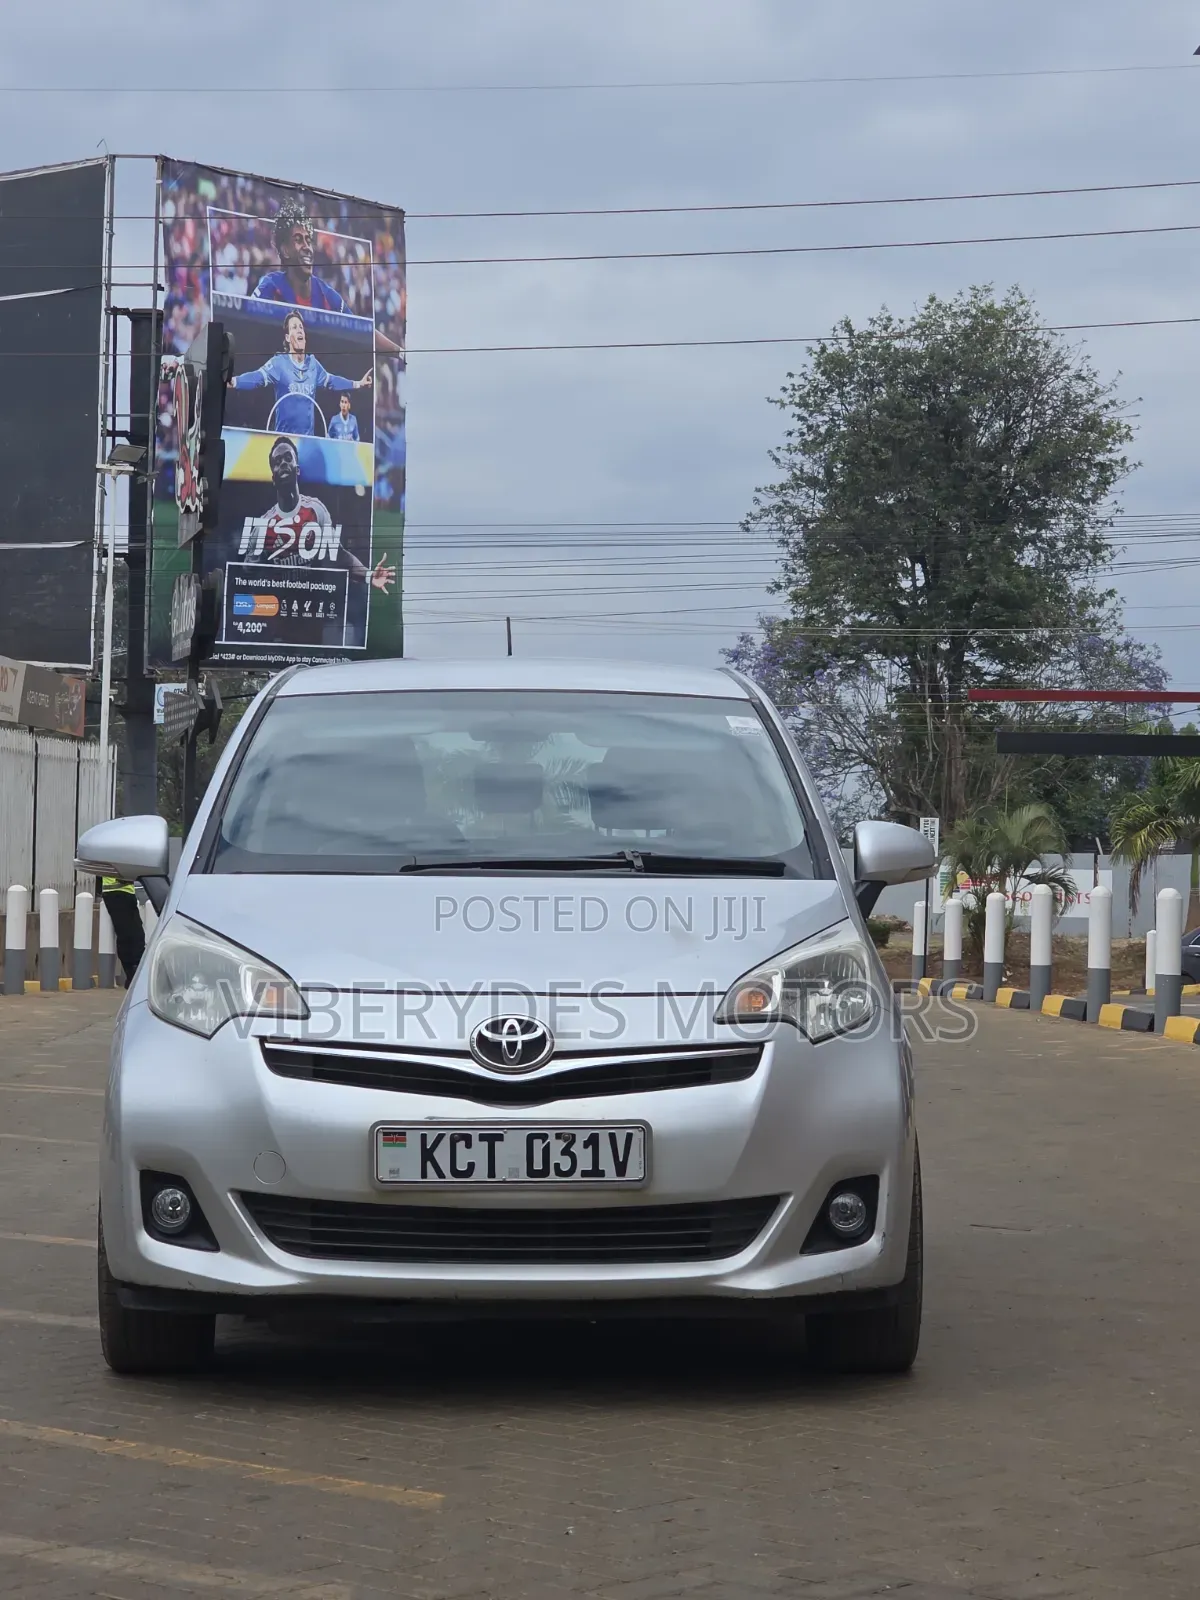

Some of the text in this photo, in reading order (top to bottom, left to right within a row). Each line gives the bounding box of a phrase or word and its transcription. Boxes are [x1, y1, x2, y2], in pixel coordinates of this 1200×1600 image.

[298, 521, 342, 561] ON
[235, 577, 336, 594] The world's best football package
[242, 653, 267, 661] Download
[286, 655, 296, 664] App
[312, 656, 336, 664] Connected
[420, 1132, 504, 1179] KCT
[526, 1132, 634, 1178] 031V
